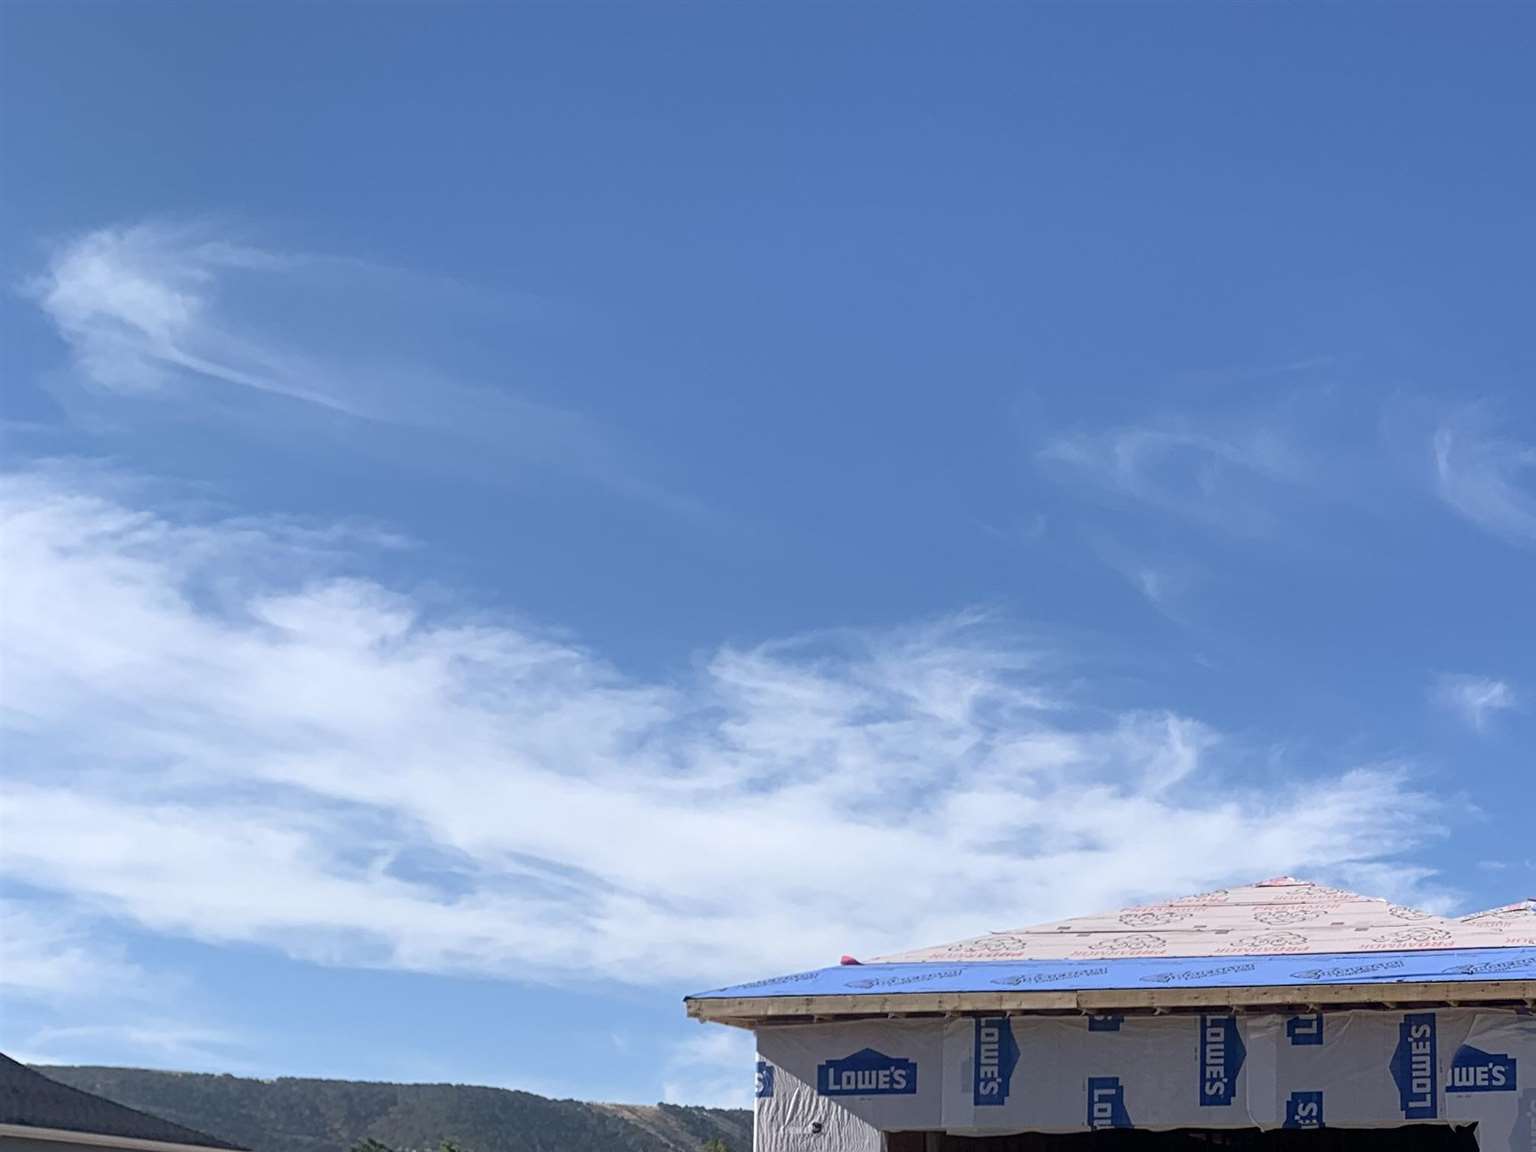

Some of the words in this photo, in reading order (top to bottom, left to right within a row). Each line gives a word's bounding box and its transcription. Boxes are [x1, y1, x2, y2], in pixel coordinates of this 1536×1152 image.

[828, 1066, 907, 1090] LOWE'S
[1205, 1015, 1229, 1096] LOWE'S
[1408, 1024, 1431, 1108] LOWE'S
